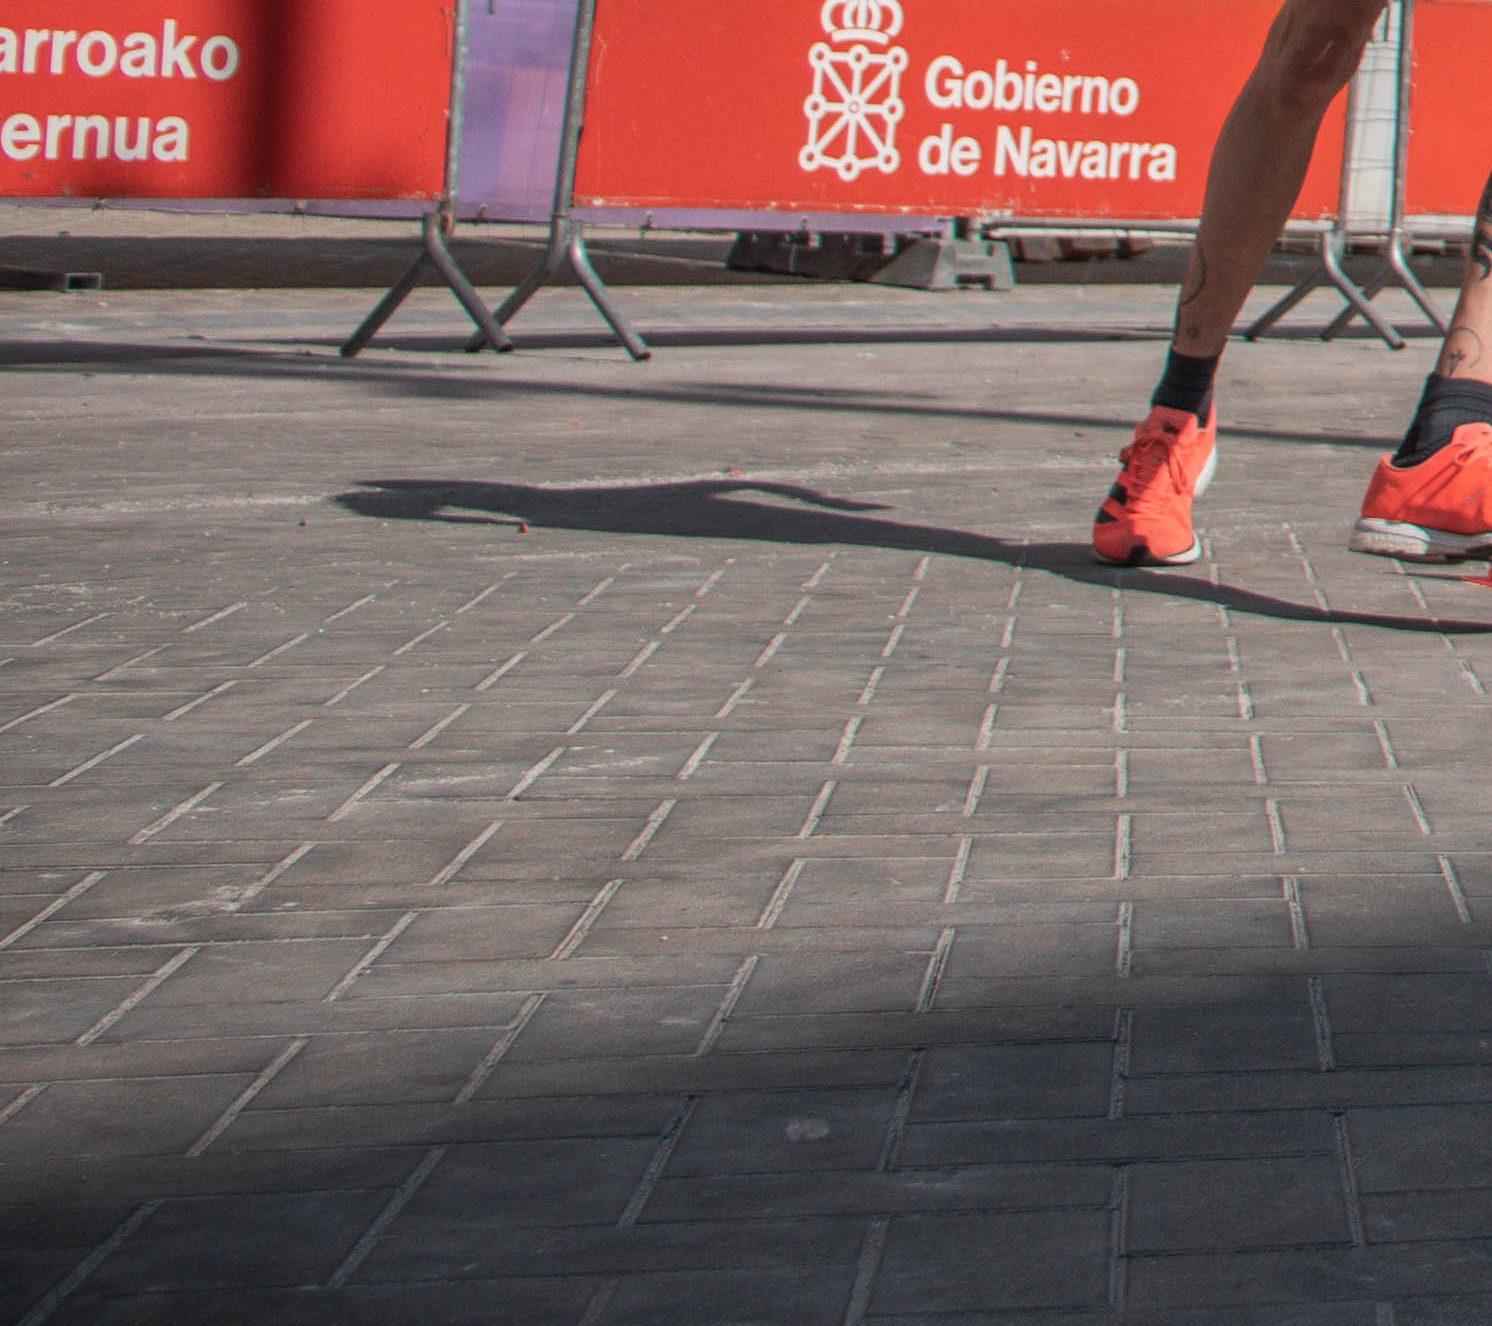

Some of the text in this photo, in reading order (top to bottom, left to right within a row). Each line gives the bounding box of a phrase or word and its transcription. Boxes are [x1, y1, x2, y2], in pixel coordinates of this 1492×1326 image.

[923, 55, 1140, 116] Gobierno
[918, 123, 1178, 181] de Navarra
